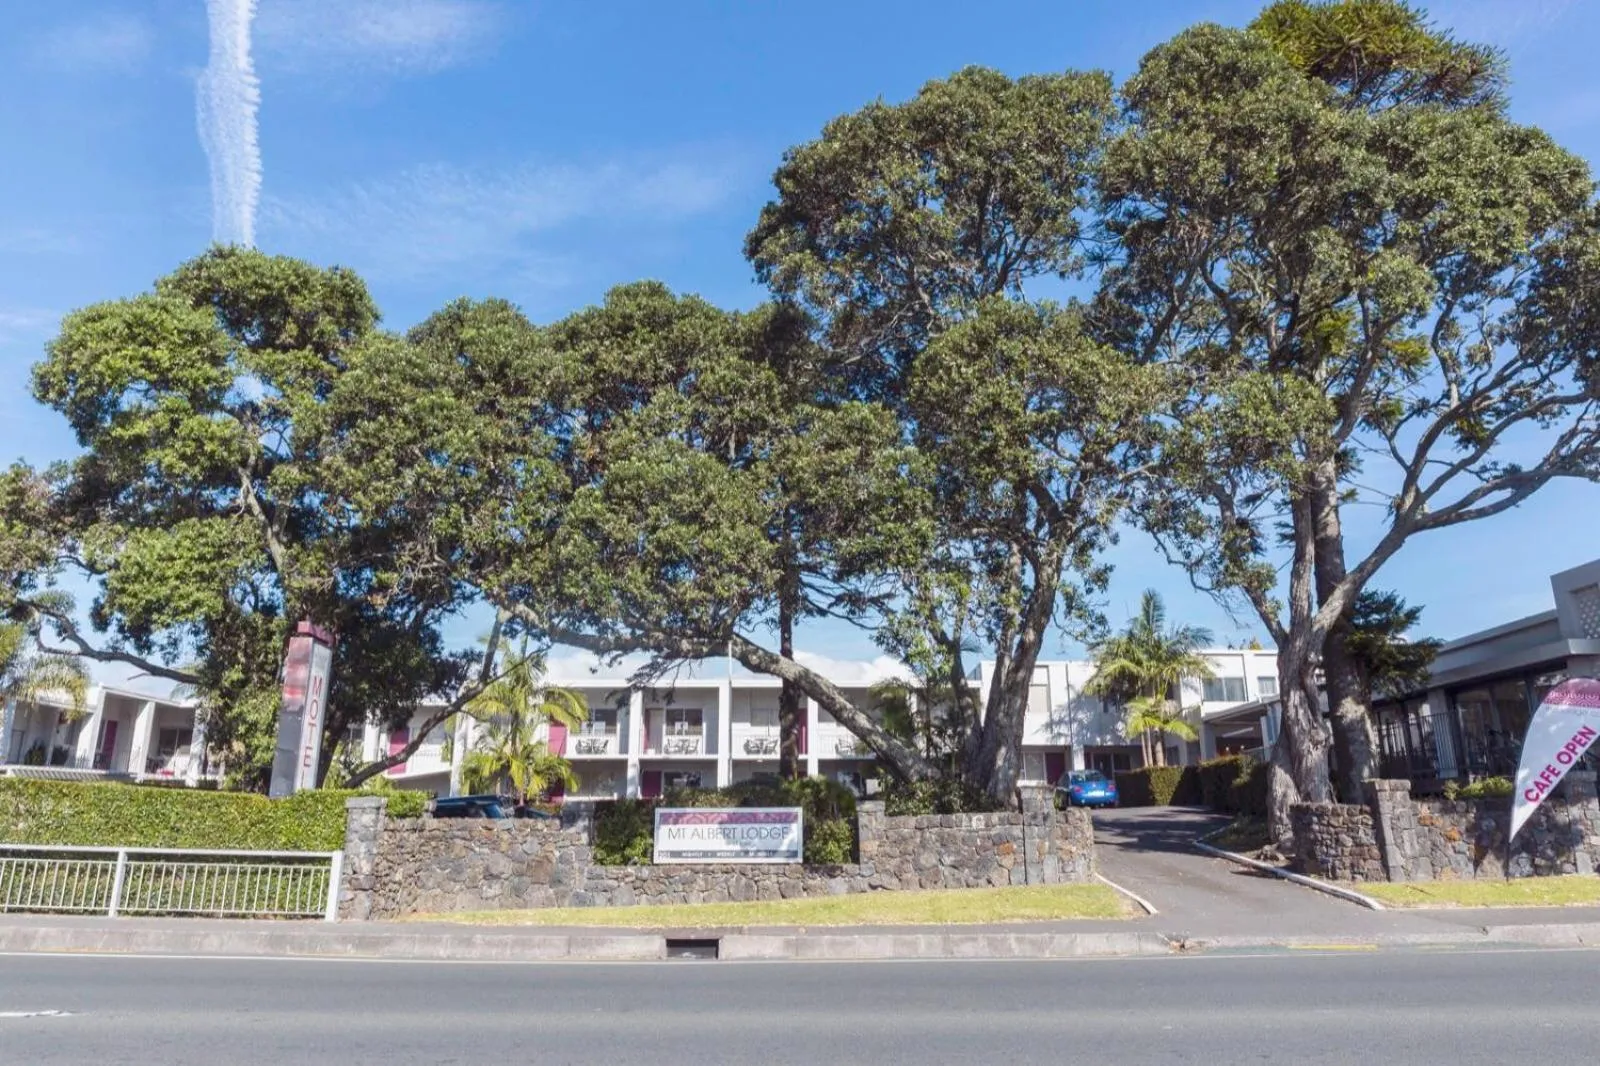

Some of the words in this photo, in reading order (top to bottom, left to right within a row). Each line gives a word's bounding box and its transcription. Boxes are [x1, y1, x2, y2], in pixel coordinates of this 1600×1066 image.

[1524, 764, 1561, 803] CAFE
[1556, 725, 1597, 764] OPEN
[668, 827, 685, 840] MT
[691, 827, 736, 840] ALBERT
[741, 826, 790, 840] LODGE
